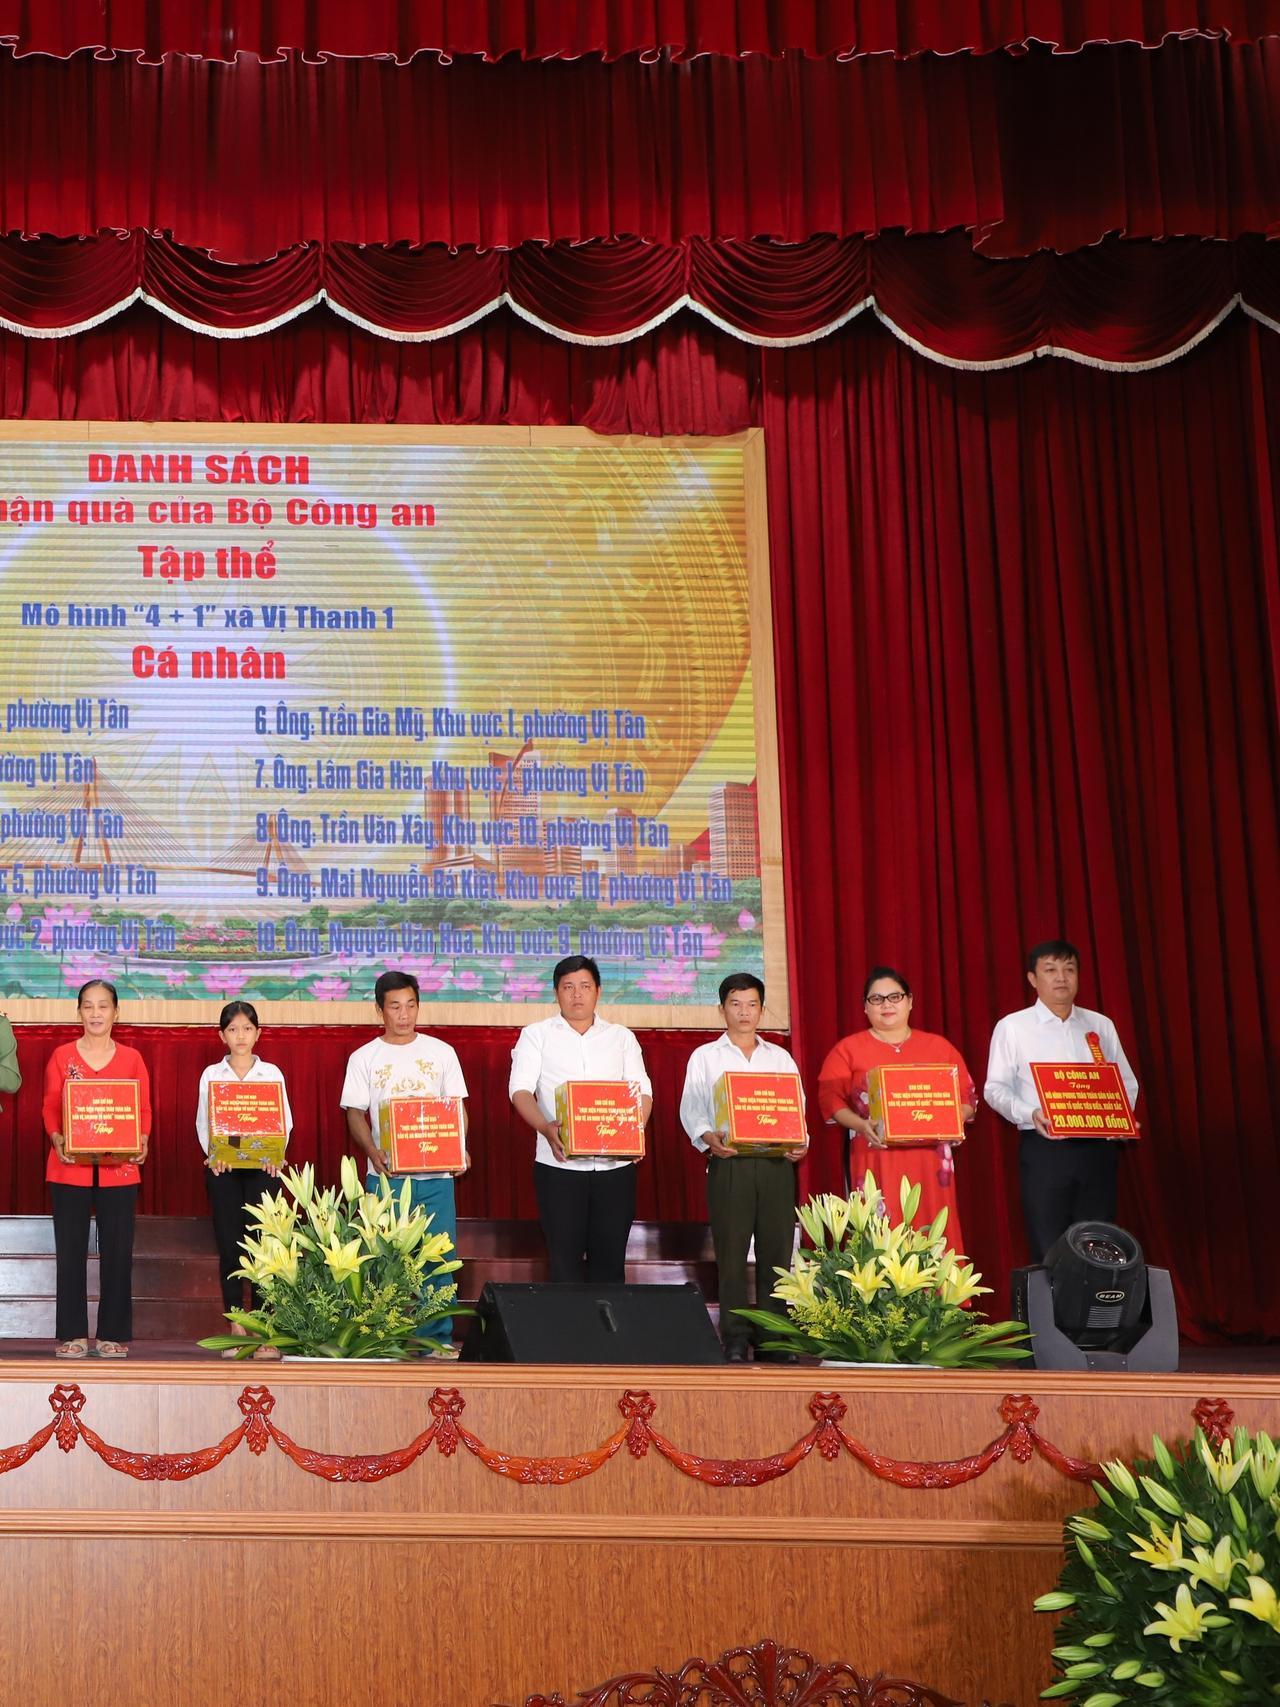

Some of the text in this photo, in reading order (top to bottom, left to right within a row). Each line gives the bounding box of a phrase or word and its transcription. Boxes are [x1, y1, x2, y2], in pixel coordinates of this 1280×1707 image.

[88, 450, 310, 485] DANH SÁCH
[67, 498, 135, 525] quà
[148, 496, 214, 525] của
[227, 498, 272, 529] Bộ
[286, 498, 377, 529] Công
[391, 502, 436, 526] an
[138, 540, 277, 584] Tập thể
[21, 603, 60, 626] Mô
[68, 603, 126, 627] hình
[168, 610, 185, 625] +
[224, 606, 254, 628] xã
[263, 606, 287, 634] Vị
[295, 606, 376, 629] Thanh
[383, 607, 394, 629] 1
[131, 644, 286, 680] Cá nhân
[7, 697, 71, 733] phường
[75, 699, 93, 735] Vị
[98, 698, 129, 729] Tân
[319, 702, 358, 736] Trần
[362, 707, 391, 736] Gia
[433, 708, 465, 736] Khu
[471, 711, 502, 745] vực
[523, 708, 587, 743] phường
[592, 709, 608, 746] Vị
[614, 709, 645, 739] Tân
[40, 753, 57, 789] Vị
[63, 752, 94, 783] Tân
[316, 759, 351, 790] Lâm
[356, 760, 385, 789] Gia
[432, 761, 465, 791] Khu
[471, 765, 502, 798] vực
[523, 762, 587, 797] phường
[591, 763, 608, 799] Vị
[613, 763, 644, 792] Tân
[1, 808, 66, 844] phường
[71, 809, 88, 846] Vị
[93, 808, 124, 838] Tân
[320, 810, 358, 843] Trần
[364, 813, 396, 844] Văn
[443, 815, 476, 845] Khu
[482, 818, 513, 851] vực
[547, 816, 611, 852] phường
[615, 816, 632, 853] Vị
[637, 817, 669, 847] Tân
[34, 863, 98, 899] phường
[103, 864, 120, 902] Vị
[125, 863, 157, 894] Tân
[321, 868, 355, 898] Mai
[361, 864, 429, 903] Nguyễn
[433, 868, 455, 898] Bá
[505, 870, 538, 899] Khu
[544, 873, 576, 908] vực
[609, 872, 674, 907] phường
[678, 872, 695, 910] Vị
[701, 872, 732, 902] Tân
